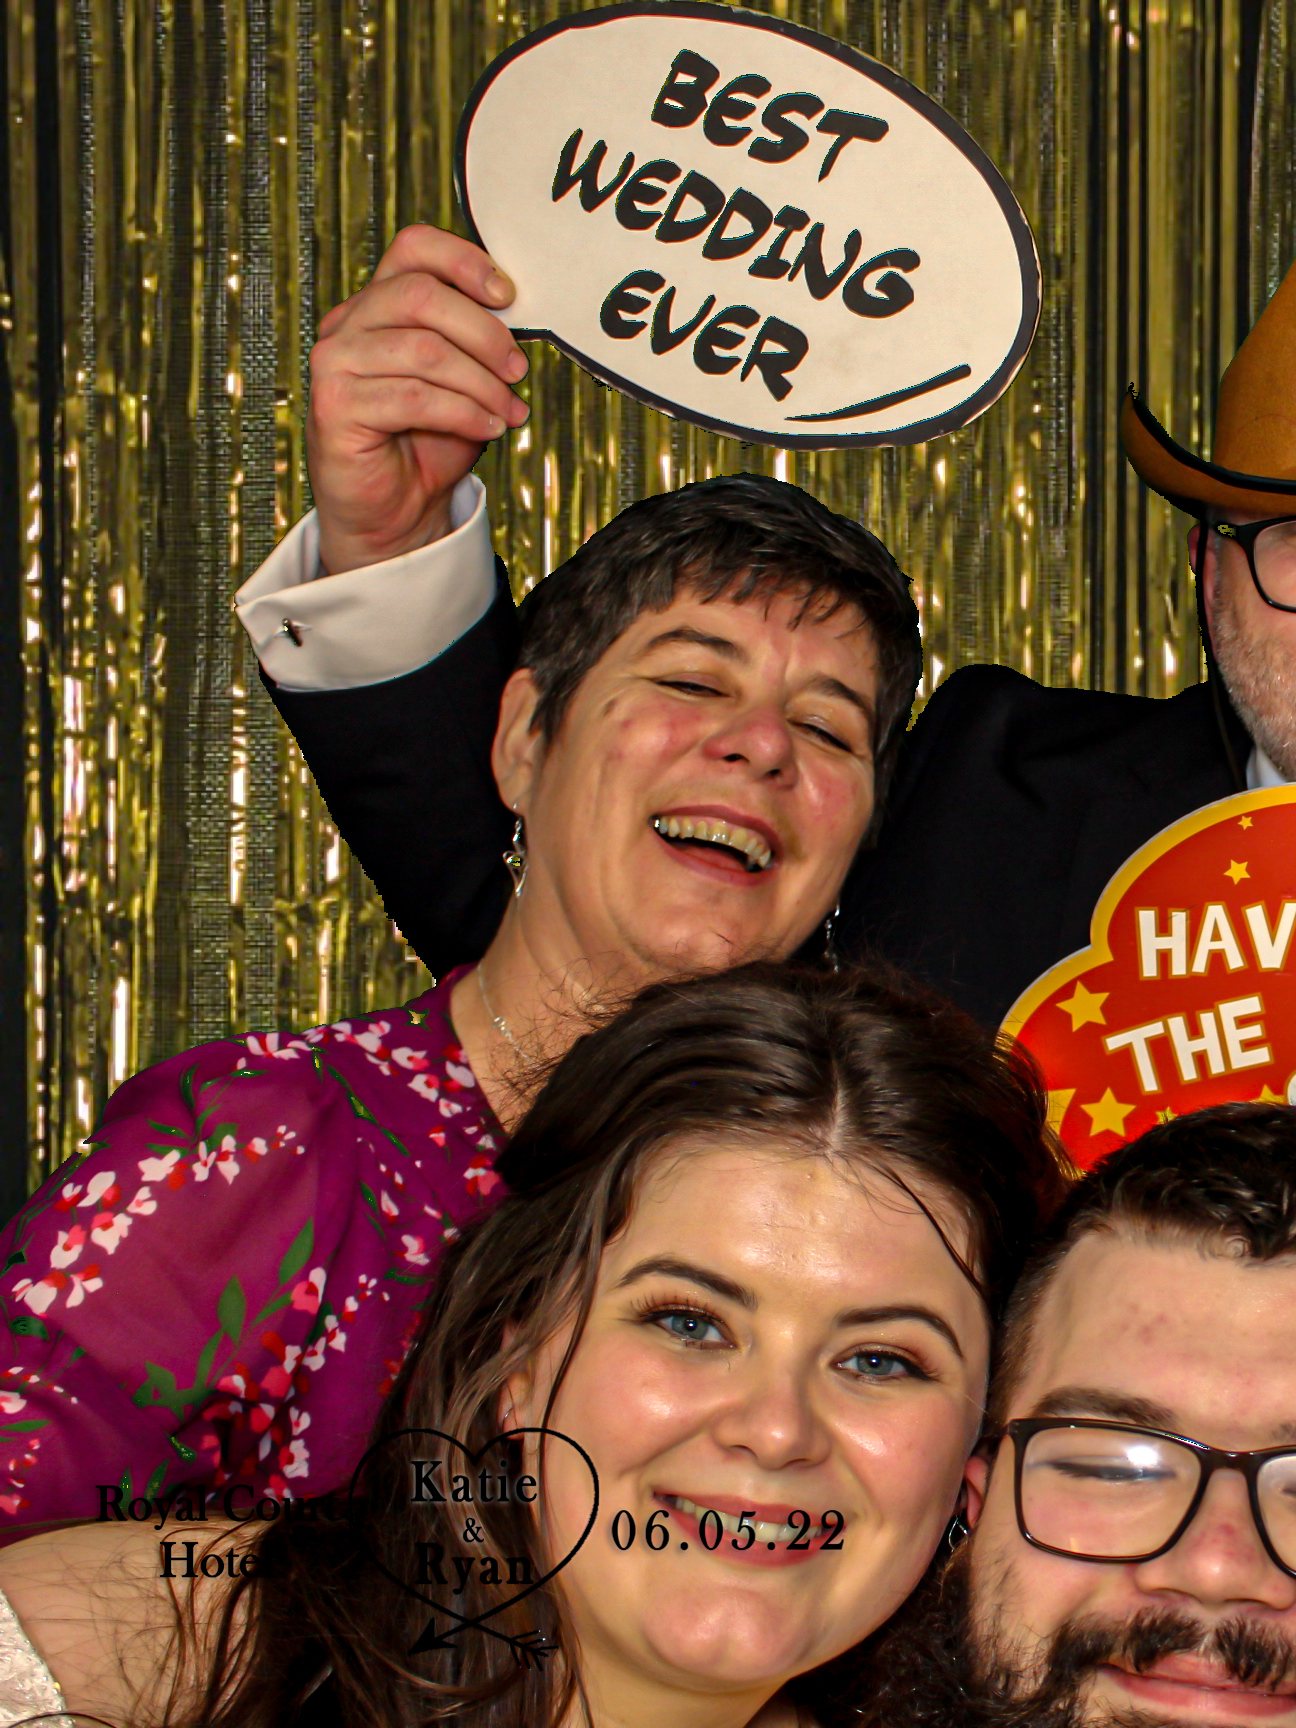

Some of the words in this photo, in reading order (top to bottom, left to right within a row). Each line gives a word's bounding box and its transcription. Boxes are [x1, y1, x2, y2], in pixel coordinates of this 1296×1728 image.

[651, 49, 889, 183] BEST
[552, 128, 921, 318] WEDDING
[600, 270, 809, 402] EVER
[1105, 995, 1271, 1093] THE
